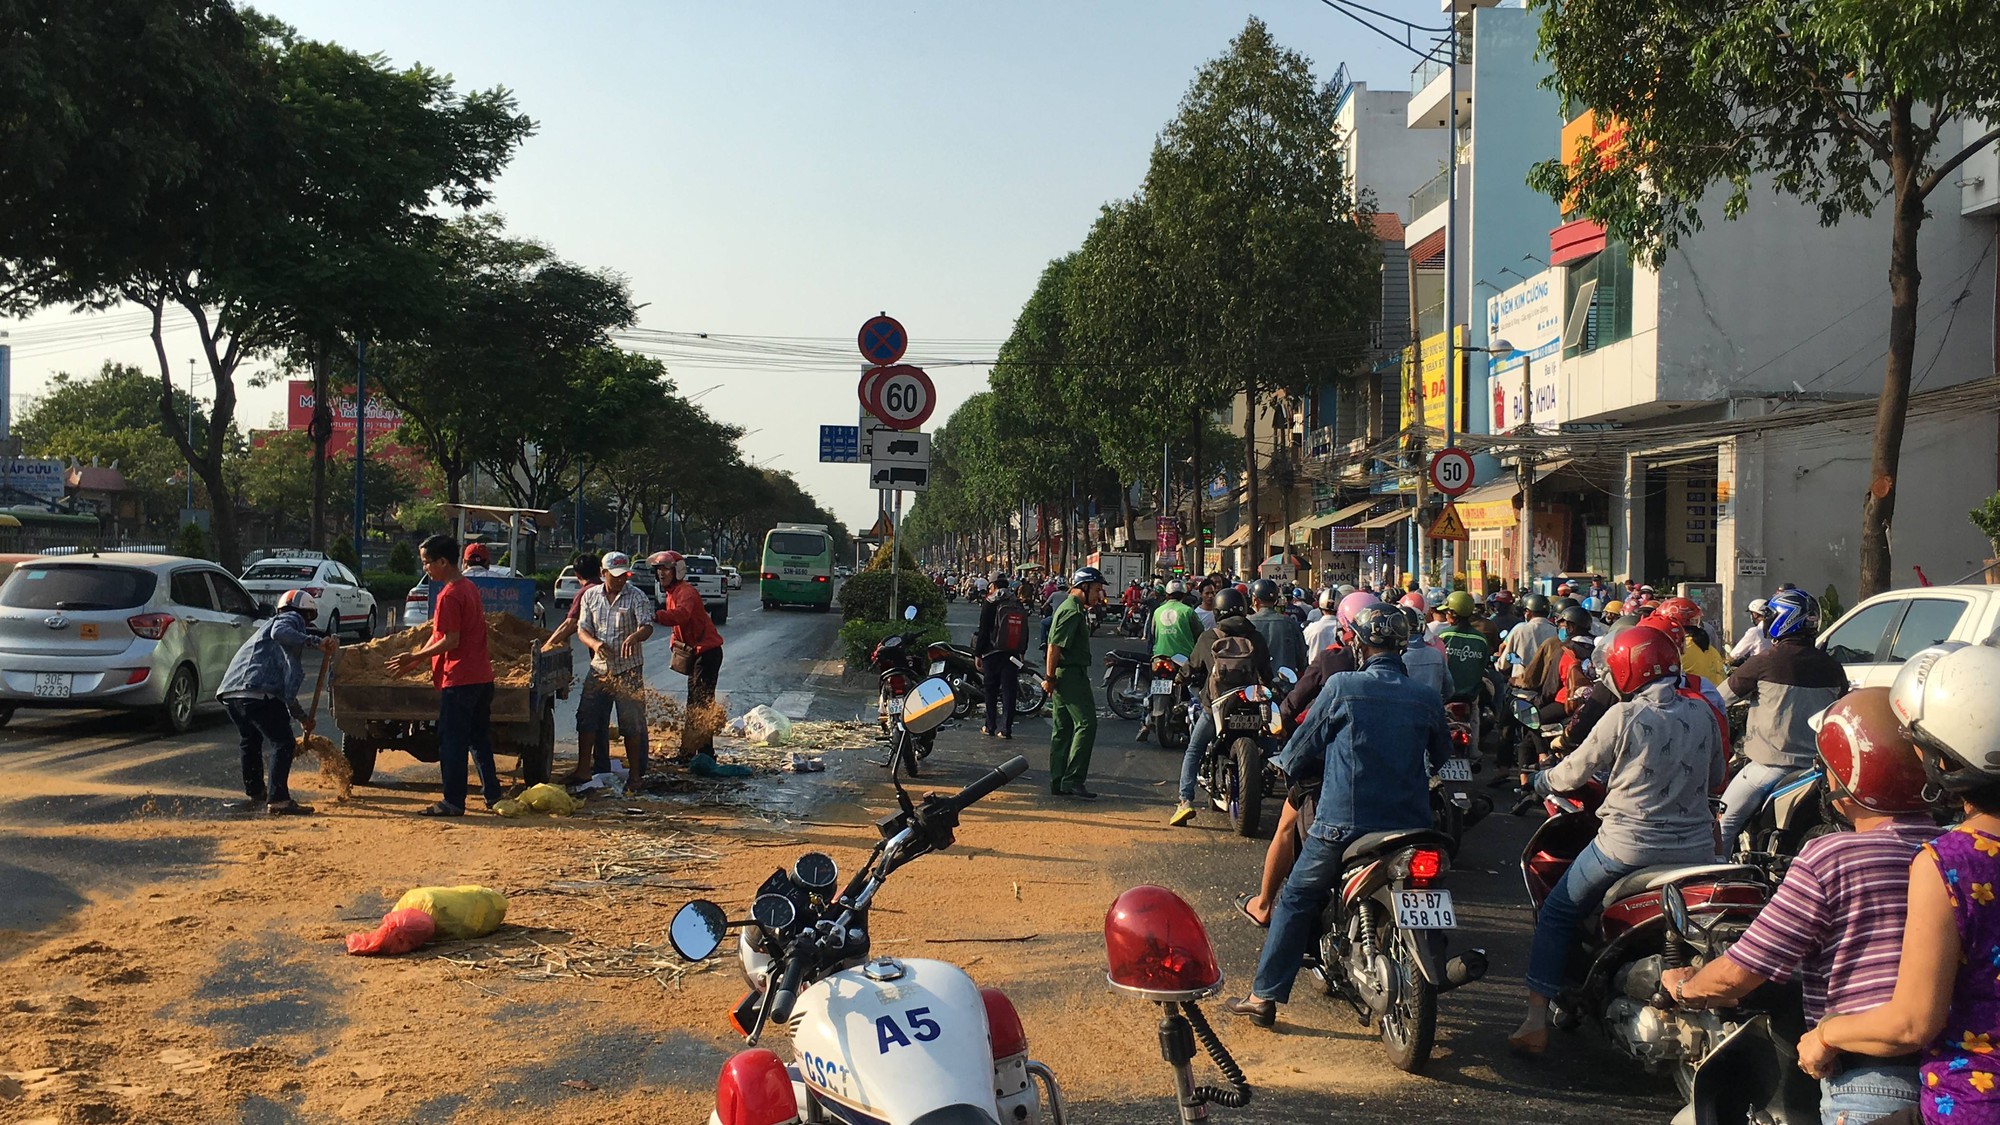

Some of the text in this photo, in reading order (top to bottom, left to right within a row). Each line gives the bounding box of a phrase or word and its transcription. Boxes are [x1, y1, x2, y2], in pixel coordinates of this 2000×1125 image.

[886, 382, 918, 413] 60
[1536, 383, 1556, 414] KHOA
[1443, 462, 1462, 482] 50
[44, 673, 64, 685] 30E
[35, 685, 70, 697] 322.33
[1440, 769, 1469, 780] 612.67
[1402, 893, 1441, 909] 63-B7
[1400, 910, 1452, 927] 458.19
[875, 1006, 941, 1055] A5
